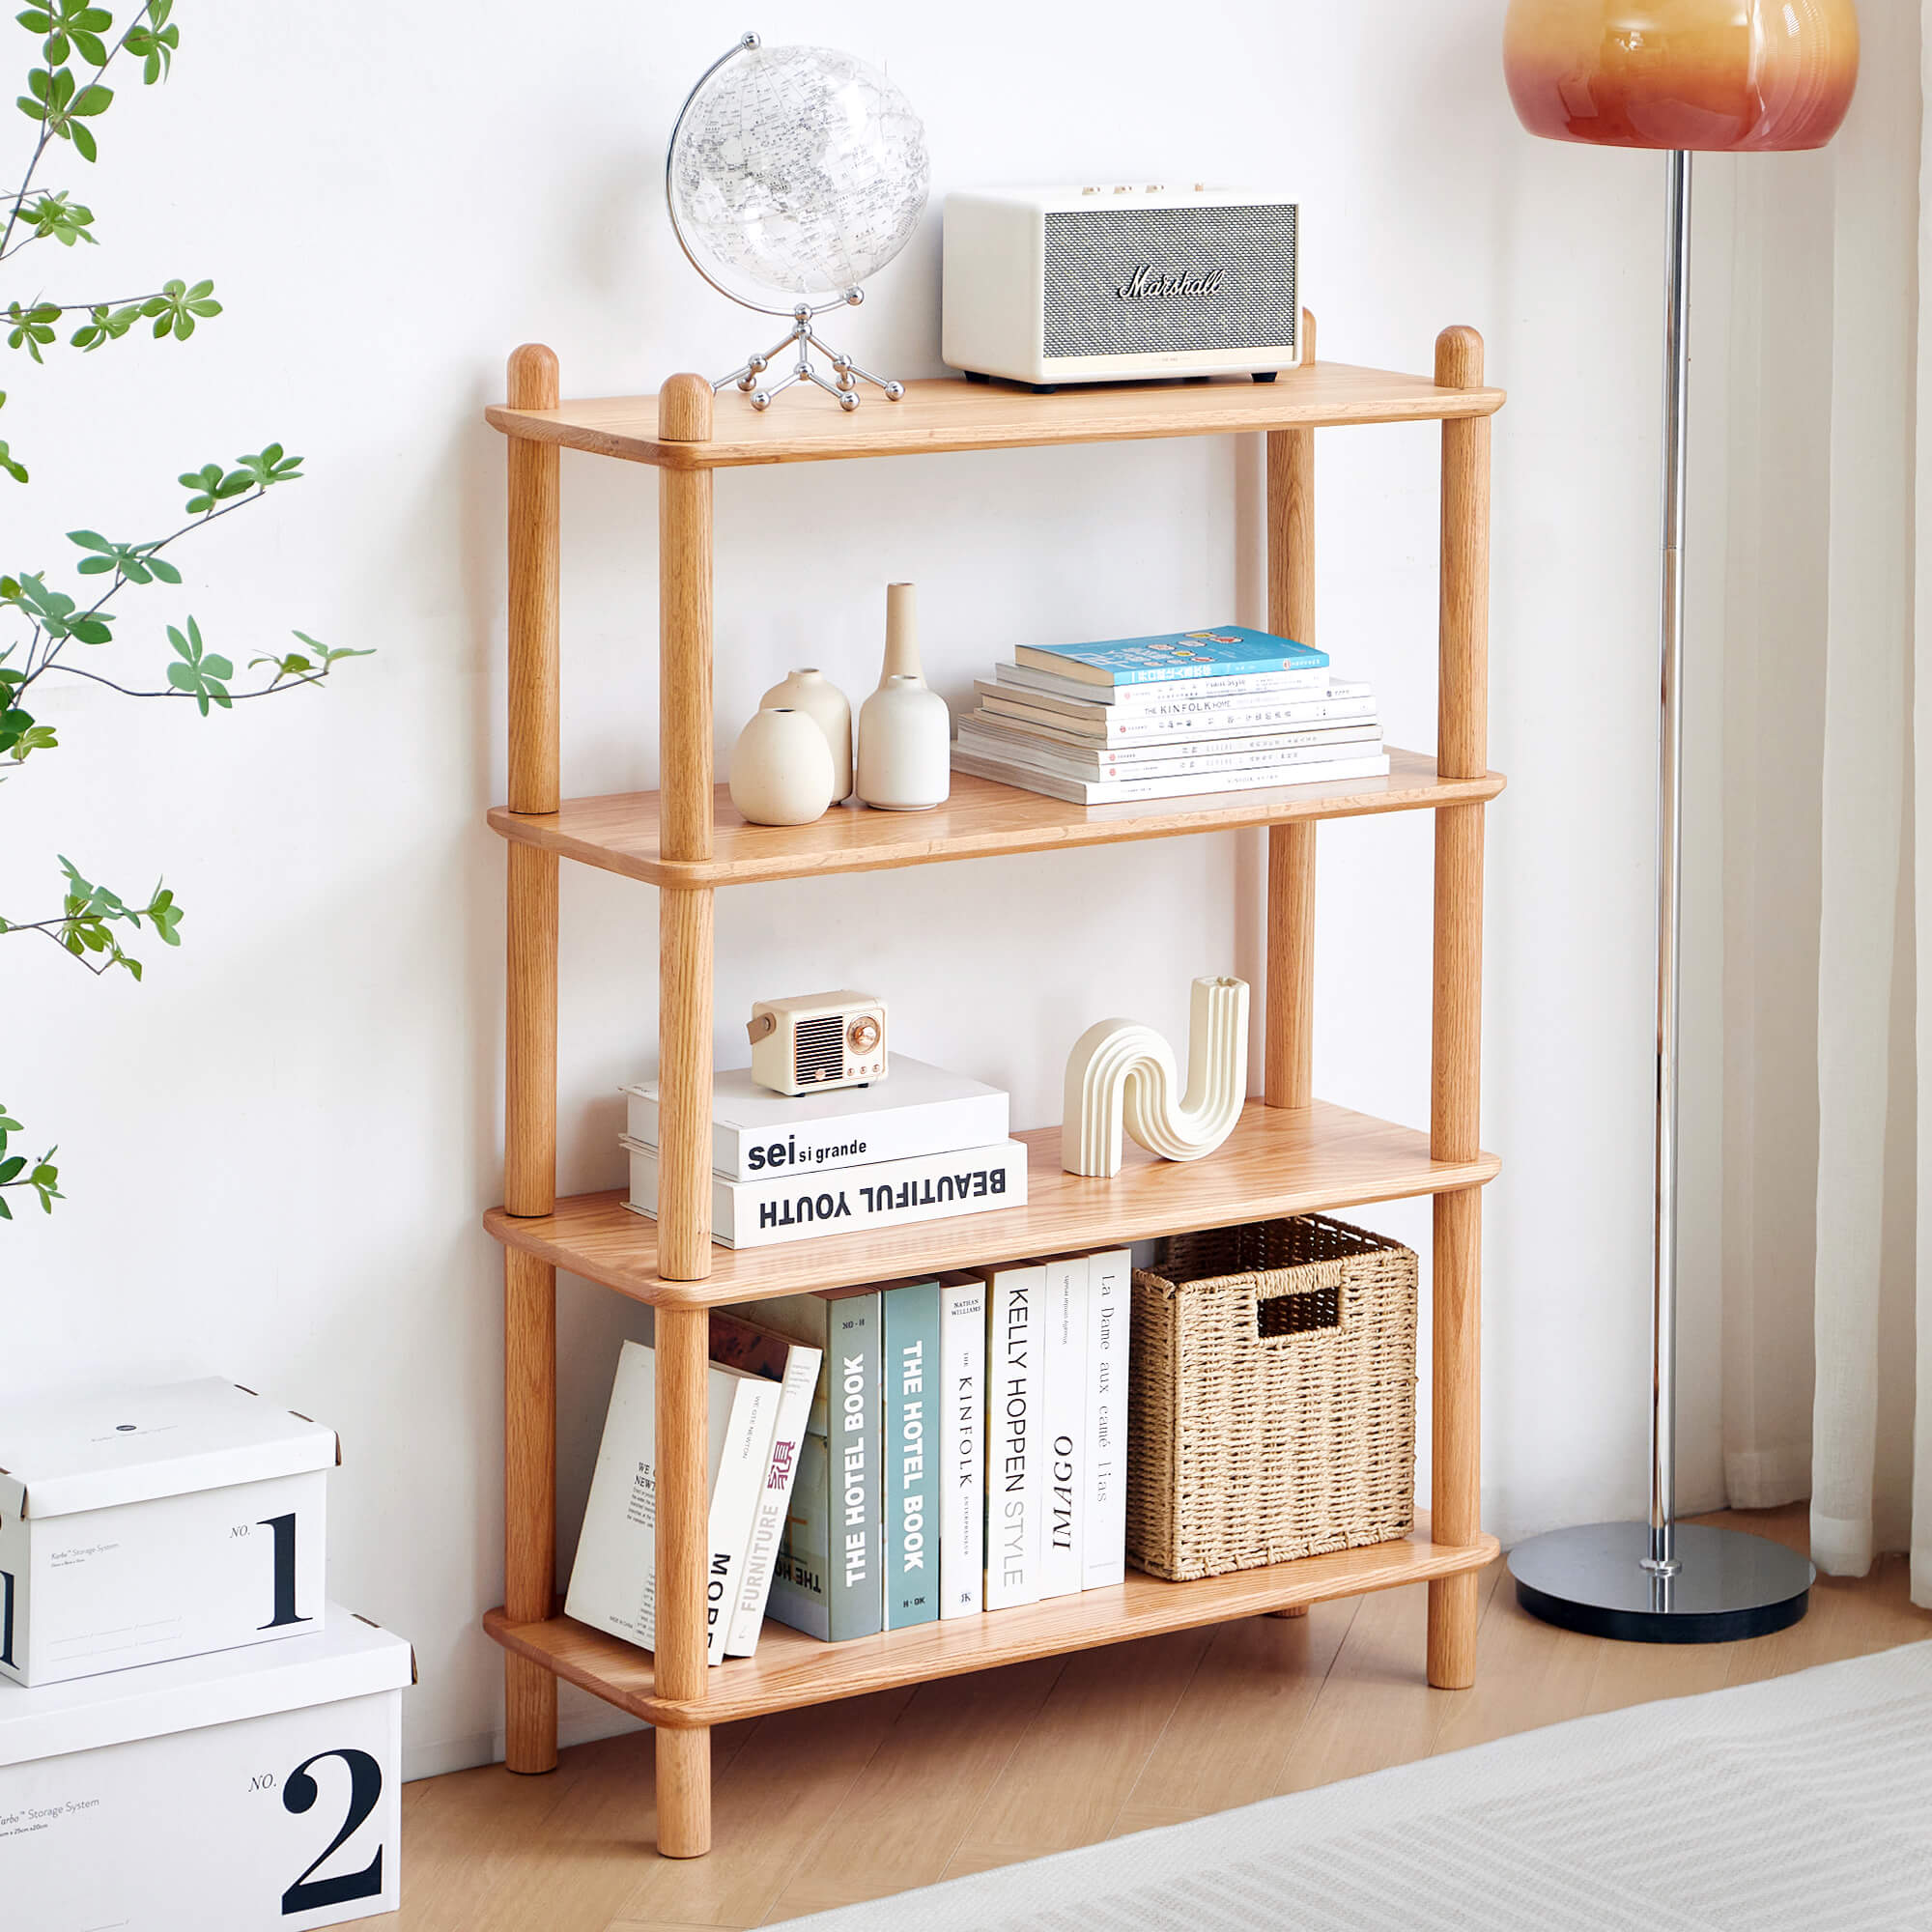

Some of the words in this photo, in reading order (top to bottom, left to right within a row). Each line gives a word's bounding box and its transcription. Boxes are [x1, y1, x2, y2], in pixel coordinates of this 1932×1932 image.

[1118, 264, 1226, 298] Marshall
[1160, 701, 1211, 715] KINFOLK
[748, 1134, 796, 1171] sei
[815, 1139, 867, 1164] grande
[759, 1191, 851, 1229] YOUTH
[860, 1168, 1007, 1213] BEAUTIFUL
[951, 1305, 981, 1316] WILLIAMS
[953, 1298, 980, 1308] NATHAN
[1009, 1288, 1029, 1369] KELLY
[1100, 1307, 1115, 1350] Dame
[843, 1352, 865, 1432] BOOK
[903, 1341, 923, 1396] THE
[1099, 1362, 1111, 1394] aux
[903, 1401, 923, 1490] HOTEL
[959, 1376, 974, 1489] KINFOLK
[1006, 1378, 1027, 1492] HOPPEN
[638, 1462, 650, 1475] WE
[767, 1440, 796, 1491] 家具
[844, 1436, 866, 1526] HOTEL
[1052, 1435, 1074, 1551] IMAGO
[741, 1504, 779, 1612] FURNITURE
[845, 1530, 867, 1588] THE
[903, 1494, 923, 1573] BOOK
[1004, 1500, 1025, 1587] STYLE
[229, 1524, 251, 1540] NO.
[255, 1512, 314, 1631] 1
[795, 1567, 821, 1594] THE
[27, 1806, 64, 1820] Storage
[65, 1798, 99, 1815] System
[248, 1774, 277, 1793] NO.
[281, 1747, 384, 1917] 2
